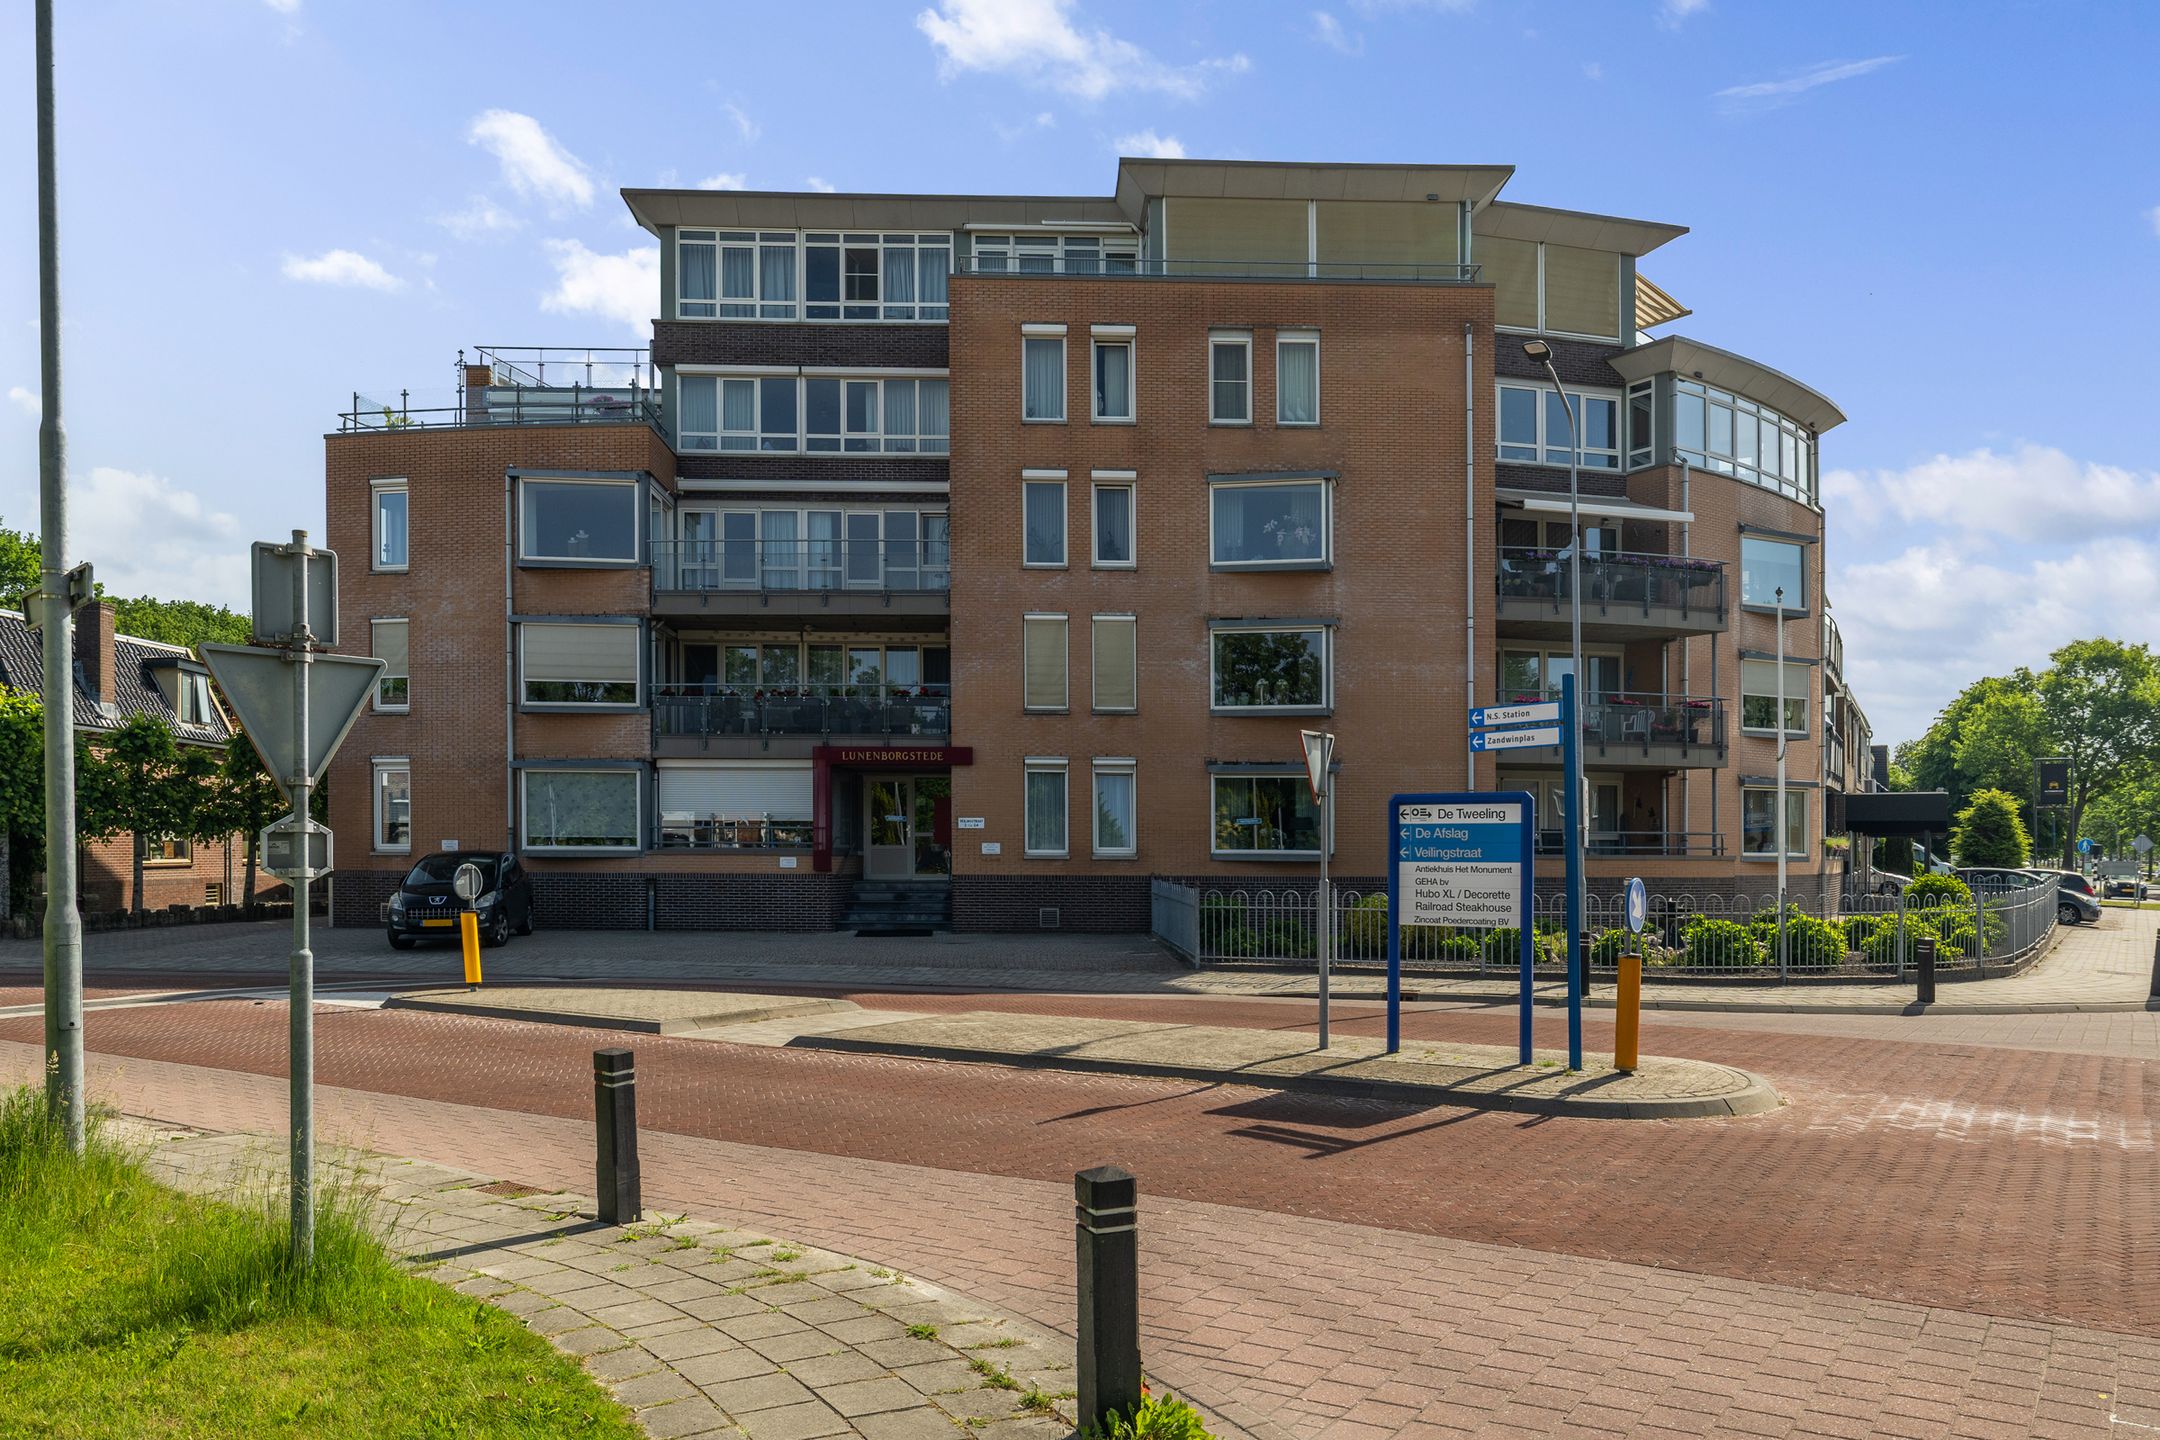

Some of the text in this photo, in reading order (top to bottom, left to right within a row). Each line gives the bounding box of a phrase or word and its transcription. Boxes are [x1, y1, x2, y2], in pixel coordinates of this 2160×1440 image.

[1486, 710, 1530, 720] N.S. Station
[1487, 734, 1535, 744] Zandwinplas
[842, 751, 945, 761] LUNENBORGSTEDE
[1437, 808, 1506, 822] De Tweeling
[1415, 827, 1469, 841] De Afslag
[1414, 846, 1482, 860] Veilingstraat
[1415, 865, 1512, 874] Antiekhuis Het Monument
[1415, 877, 1450, 886] GEHA bv
[1415, 889, 1441, 898] Hubo
[1442, 889, 1455, 899] XL
[1464, 889, 1511, 900] Decorette
[1415, 901, 1512, 913] Railroad Steakhouse
[1414, 915, 1510, 927] Zincoat Poedercoating BV
